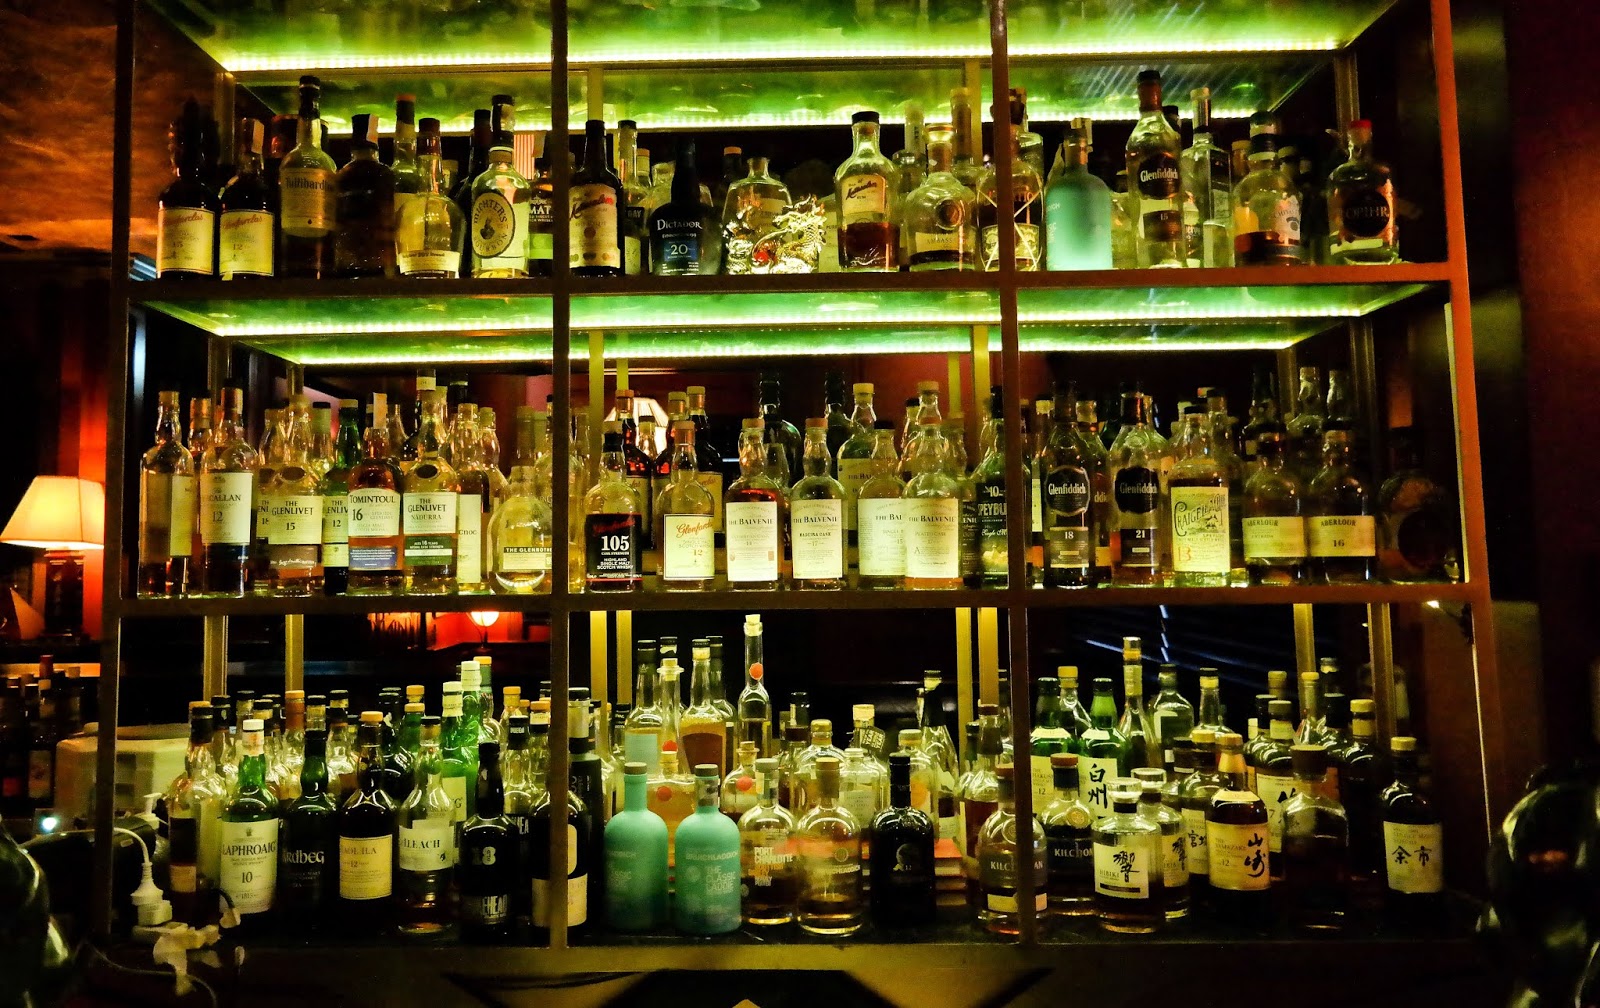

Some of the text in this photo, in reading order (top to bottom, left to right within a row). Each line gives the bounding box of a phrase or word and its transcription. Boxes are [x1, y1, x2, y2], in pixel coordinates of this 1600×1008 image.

[1140, 168, 1178, 182] Glenfiddich
[670, 244, 688, 255] 20
[1048, 483, 1086, 496] Glenfiddich
[1119, 482, 1158, 494] Glenfiddich
[350, 494, 395, 504] TOMINTOUL
[272, 506, 314, 516] GLENLIVET
[408, 504, 446, 512] GLENLIVET
[213, 512, 223, 522] 12
[352, 508, 364, 520] 16
[286, 522, 296, 530] 15
[332, 520, 342, 528] 12
[1136, 530, 1146, 538] 21
[601, 535, 630, 551] 105
[1088, 763, 1108, 808] 白州
[222, 841, 276, 856] LAPHROAIG
[754, 847, 774, 855] PORT
[1054, 842, 1092, 858] KILCHO
[1392, 846, 1432, 867] 余市
[242, 872, 253, 883] 10
